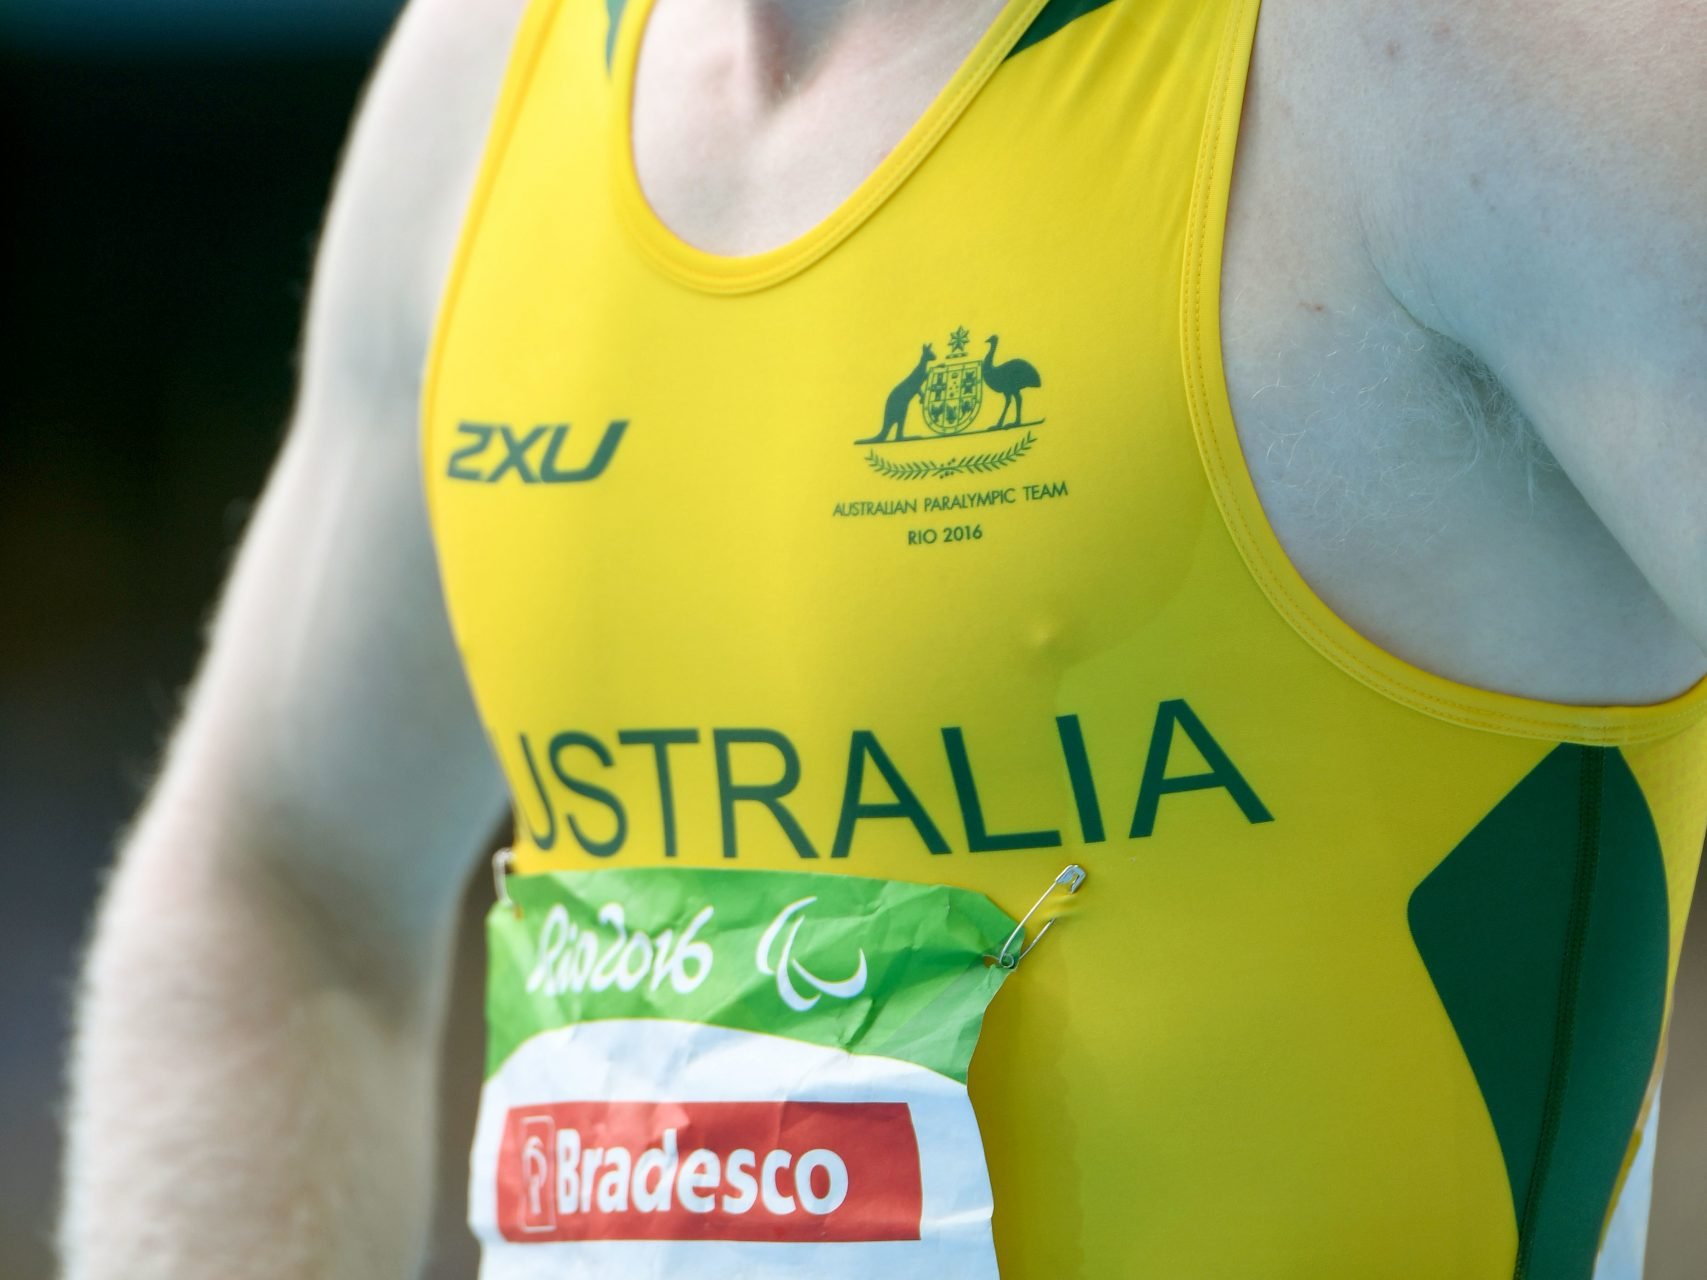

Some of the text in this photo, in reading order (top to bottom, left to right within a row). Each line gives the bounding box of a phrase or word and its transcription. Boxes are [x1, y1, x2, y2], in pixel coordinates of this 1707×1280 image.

[447, 420, 629, 483] 2XU
[832, 481, 1068, 517] AUSTRALIAN PARALYMPIC TEAM
[908, 524, 983, 545] RIO 2016
[555, 1128, 849, 1216] Bradesco
